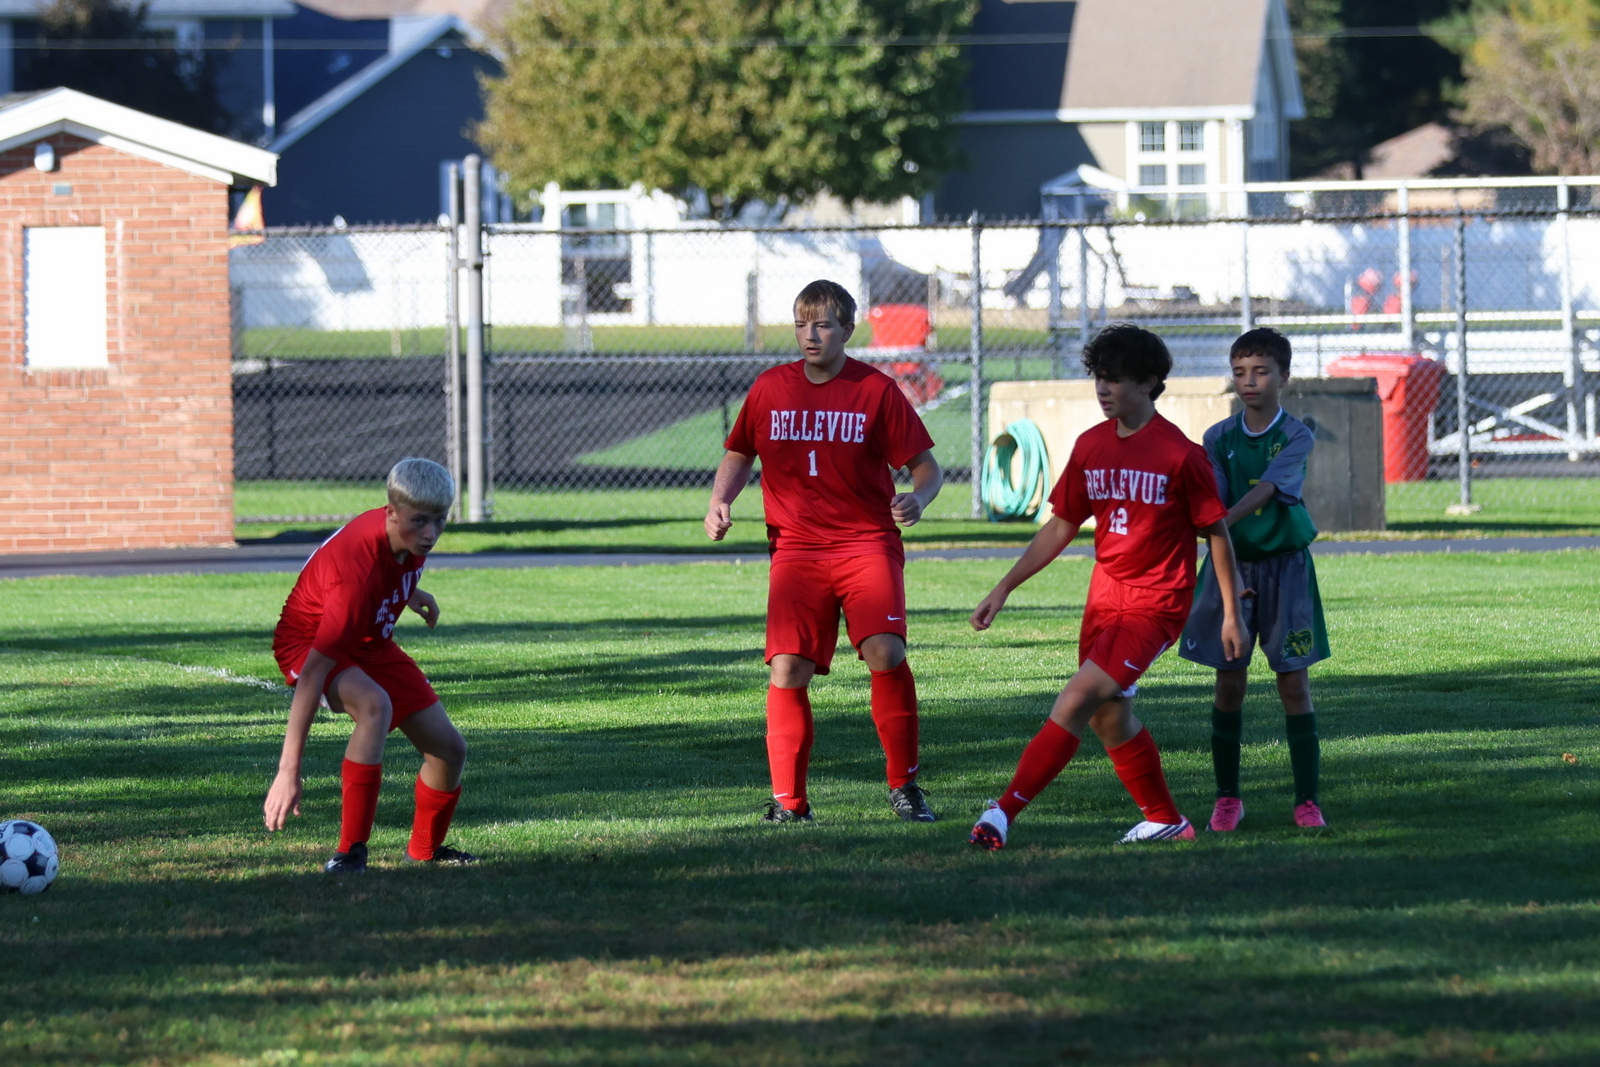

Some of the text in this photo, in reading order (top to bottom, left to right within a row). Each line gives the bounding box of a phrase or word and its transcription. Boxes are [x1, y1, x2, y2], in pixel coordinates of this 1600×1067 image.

[770, 410, 866, 443] BELLEVUE
[808, 450, 818, 476] 1
[1084, 469, 1168, 504] BELLEVUE
